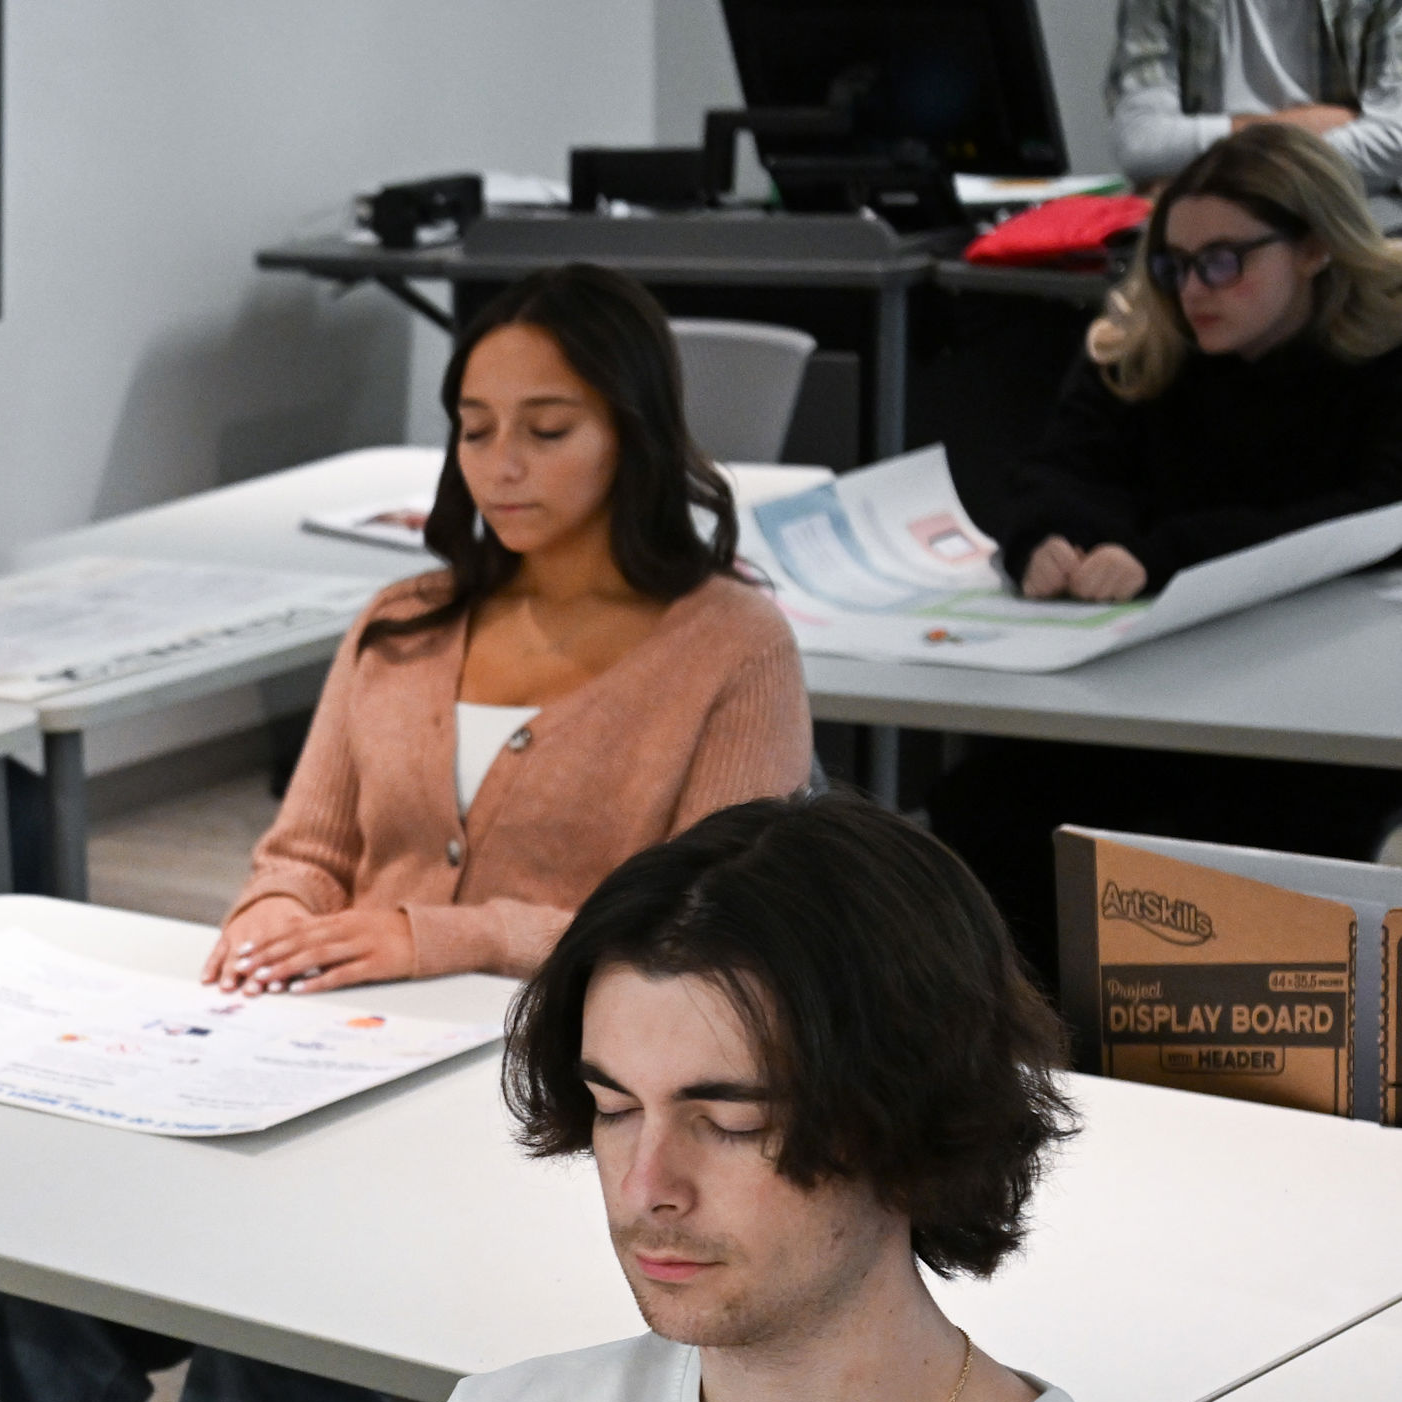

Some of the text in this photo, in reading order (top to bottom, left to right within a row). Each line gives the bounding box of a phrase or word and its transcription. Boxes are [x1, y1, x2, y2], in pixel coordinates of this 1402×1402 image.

[1102, 881, 1216, 939] ArtSkills
[1107, 978, 1163, 1005] Project
[1110, 1003, 1334, 1035] DISPLAY BOARD
[1198, 1050, 1276, 1070] HEADER
